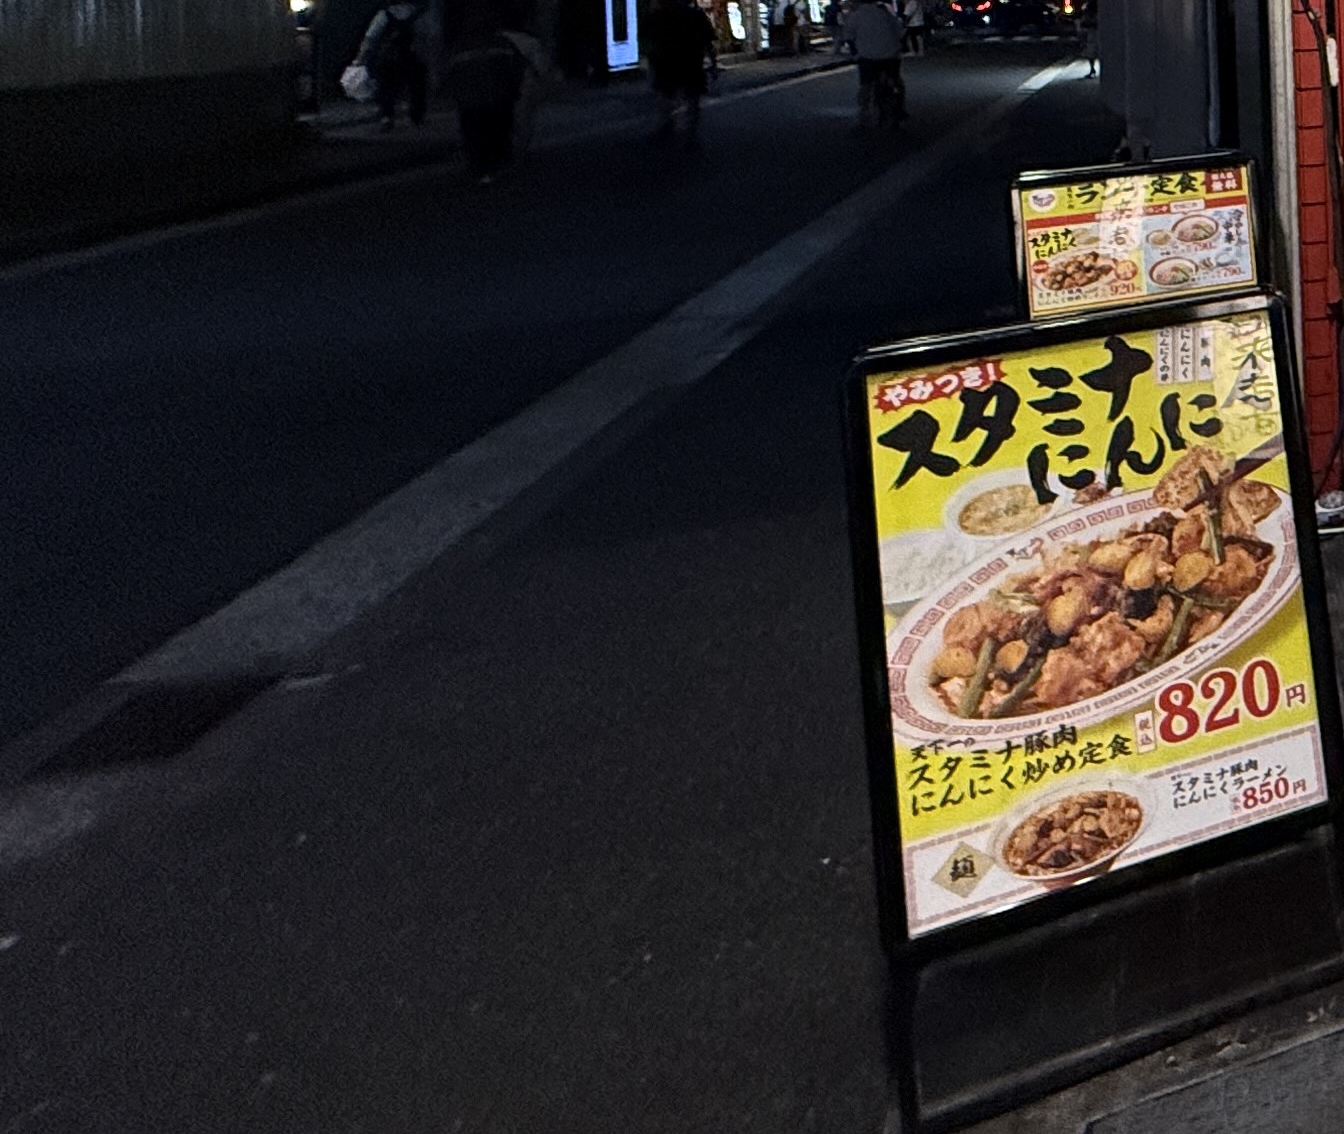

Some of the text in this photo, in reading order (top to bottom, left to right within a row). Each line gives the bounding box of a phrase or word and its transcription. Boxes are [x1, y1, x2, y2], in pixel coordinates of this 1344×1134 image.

[877, 335, 1154, 491] スタミナ
[908, 723, 1078, 790] スタミナ豚肉
[911, 733, 1133, 817] にんにく炒め定食
[1172, 758, 1259, 795] スタミナ豚肉
[1173, 764, 1288, 809] にんにくラーメン
